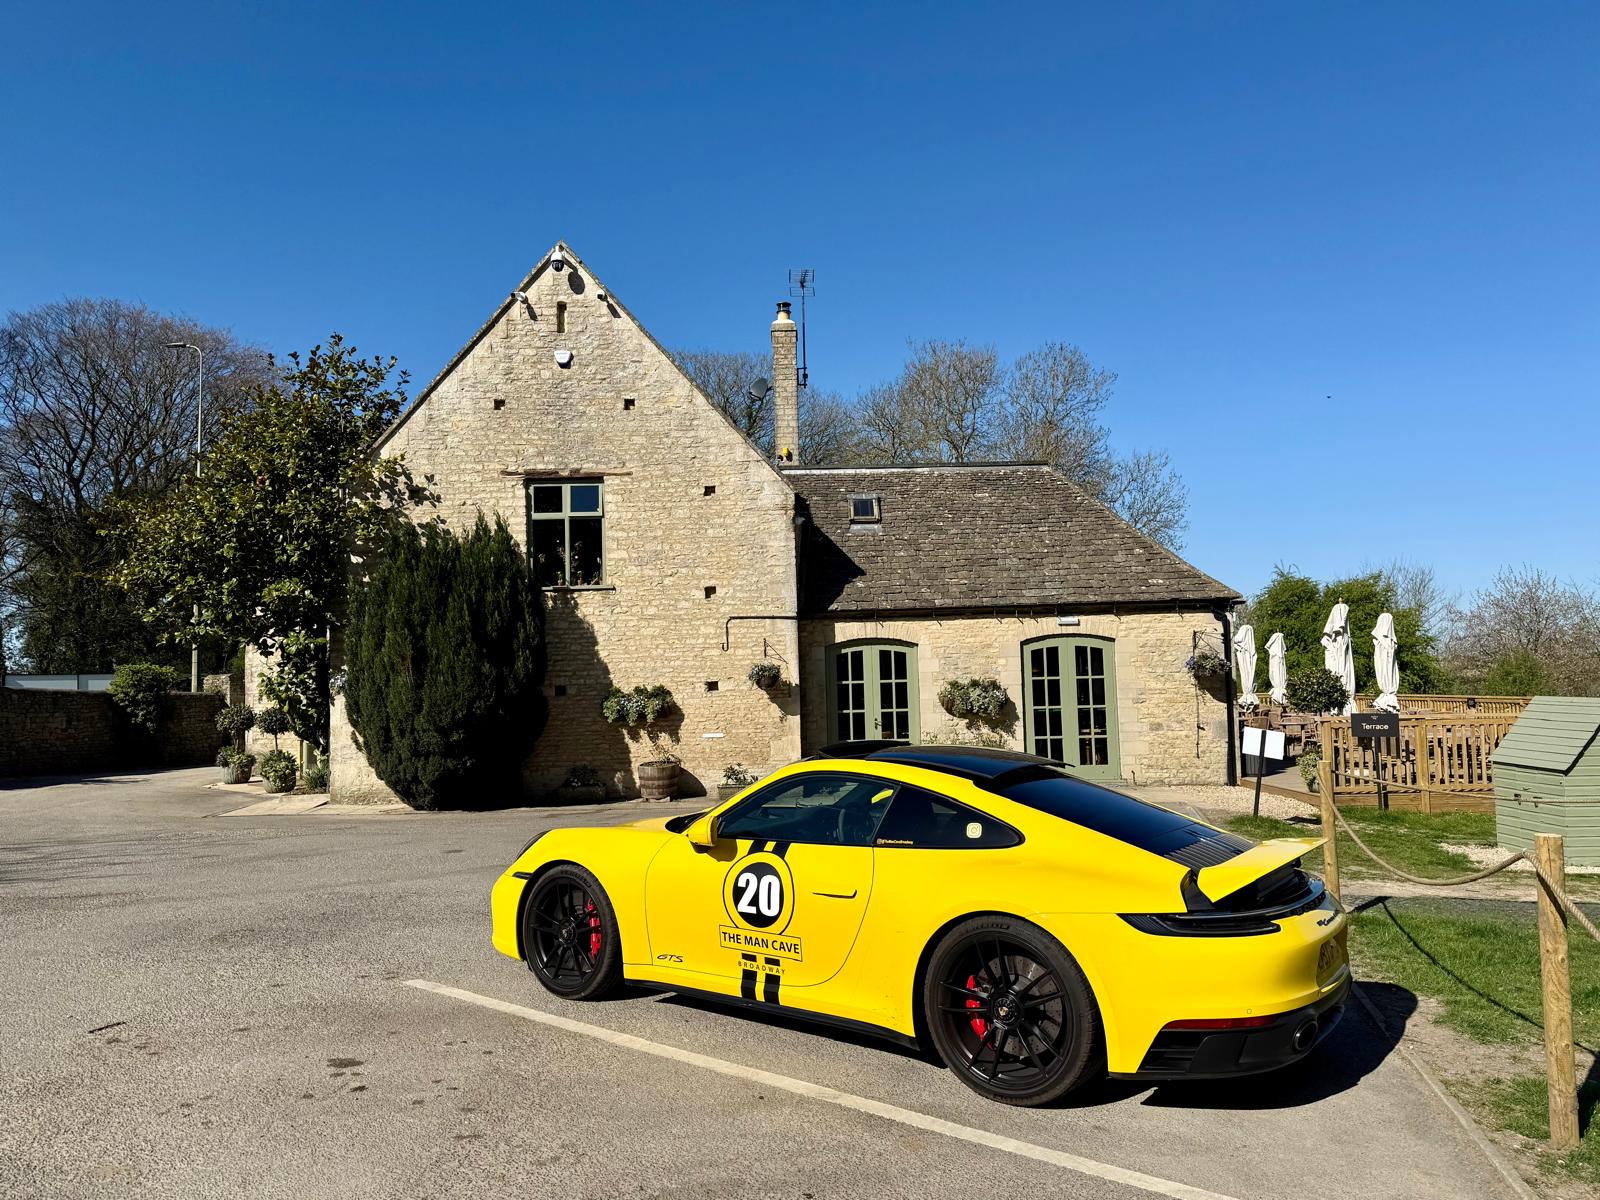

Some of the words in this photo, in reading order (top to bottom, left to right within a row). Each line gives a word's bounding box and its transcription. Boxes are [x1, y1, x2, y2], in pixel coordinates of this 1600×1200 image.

[1361, 722, 1389, 730] Terrace
[737, 872, 781, 917] 20
[721, 931, 742, 945] THE
[744, 935, 769, 949] MAN
[771, 940, 800, 954] CAVE
[657, 954, 684, 963] GTS
[737, 960, 786, 975] BROADWAY
